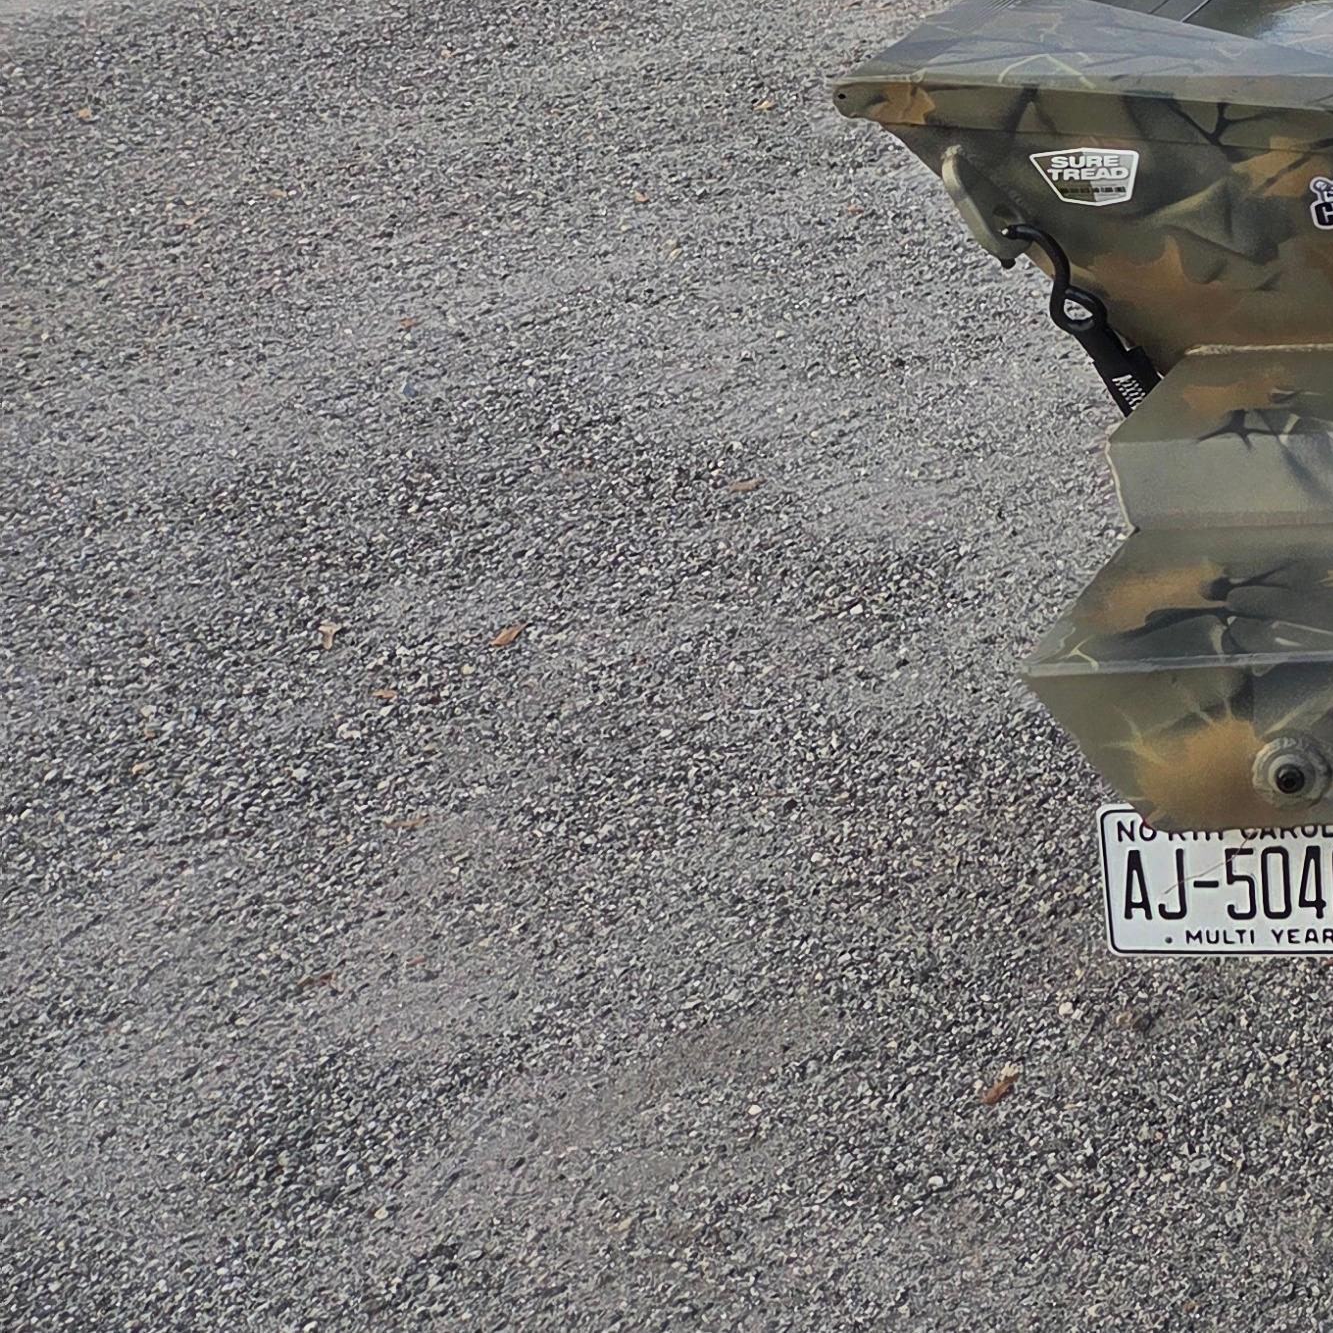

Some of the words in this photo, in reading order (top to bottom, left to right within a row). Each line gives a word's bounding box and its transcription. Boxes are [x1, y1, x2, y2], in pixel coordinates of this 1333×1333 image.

[1050, 155, 1119, 169] SURE
[1046, 167, 1129, 182] TREAD
[1185, 929, 1255, 945] MULTI
